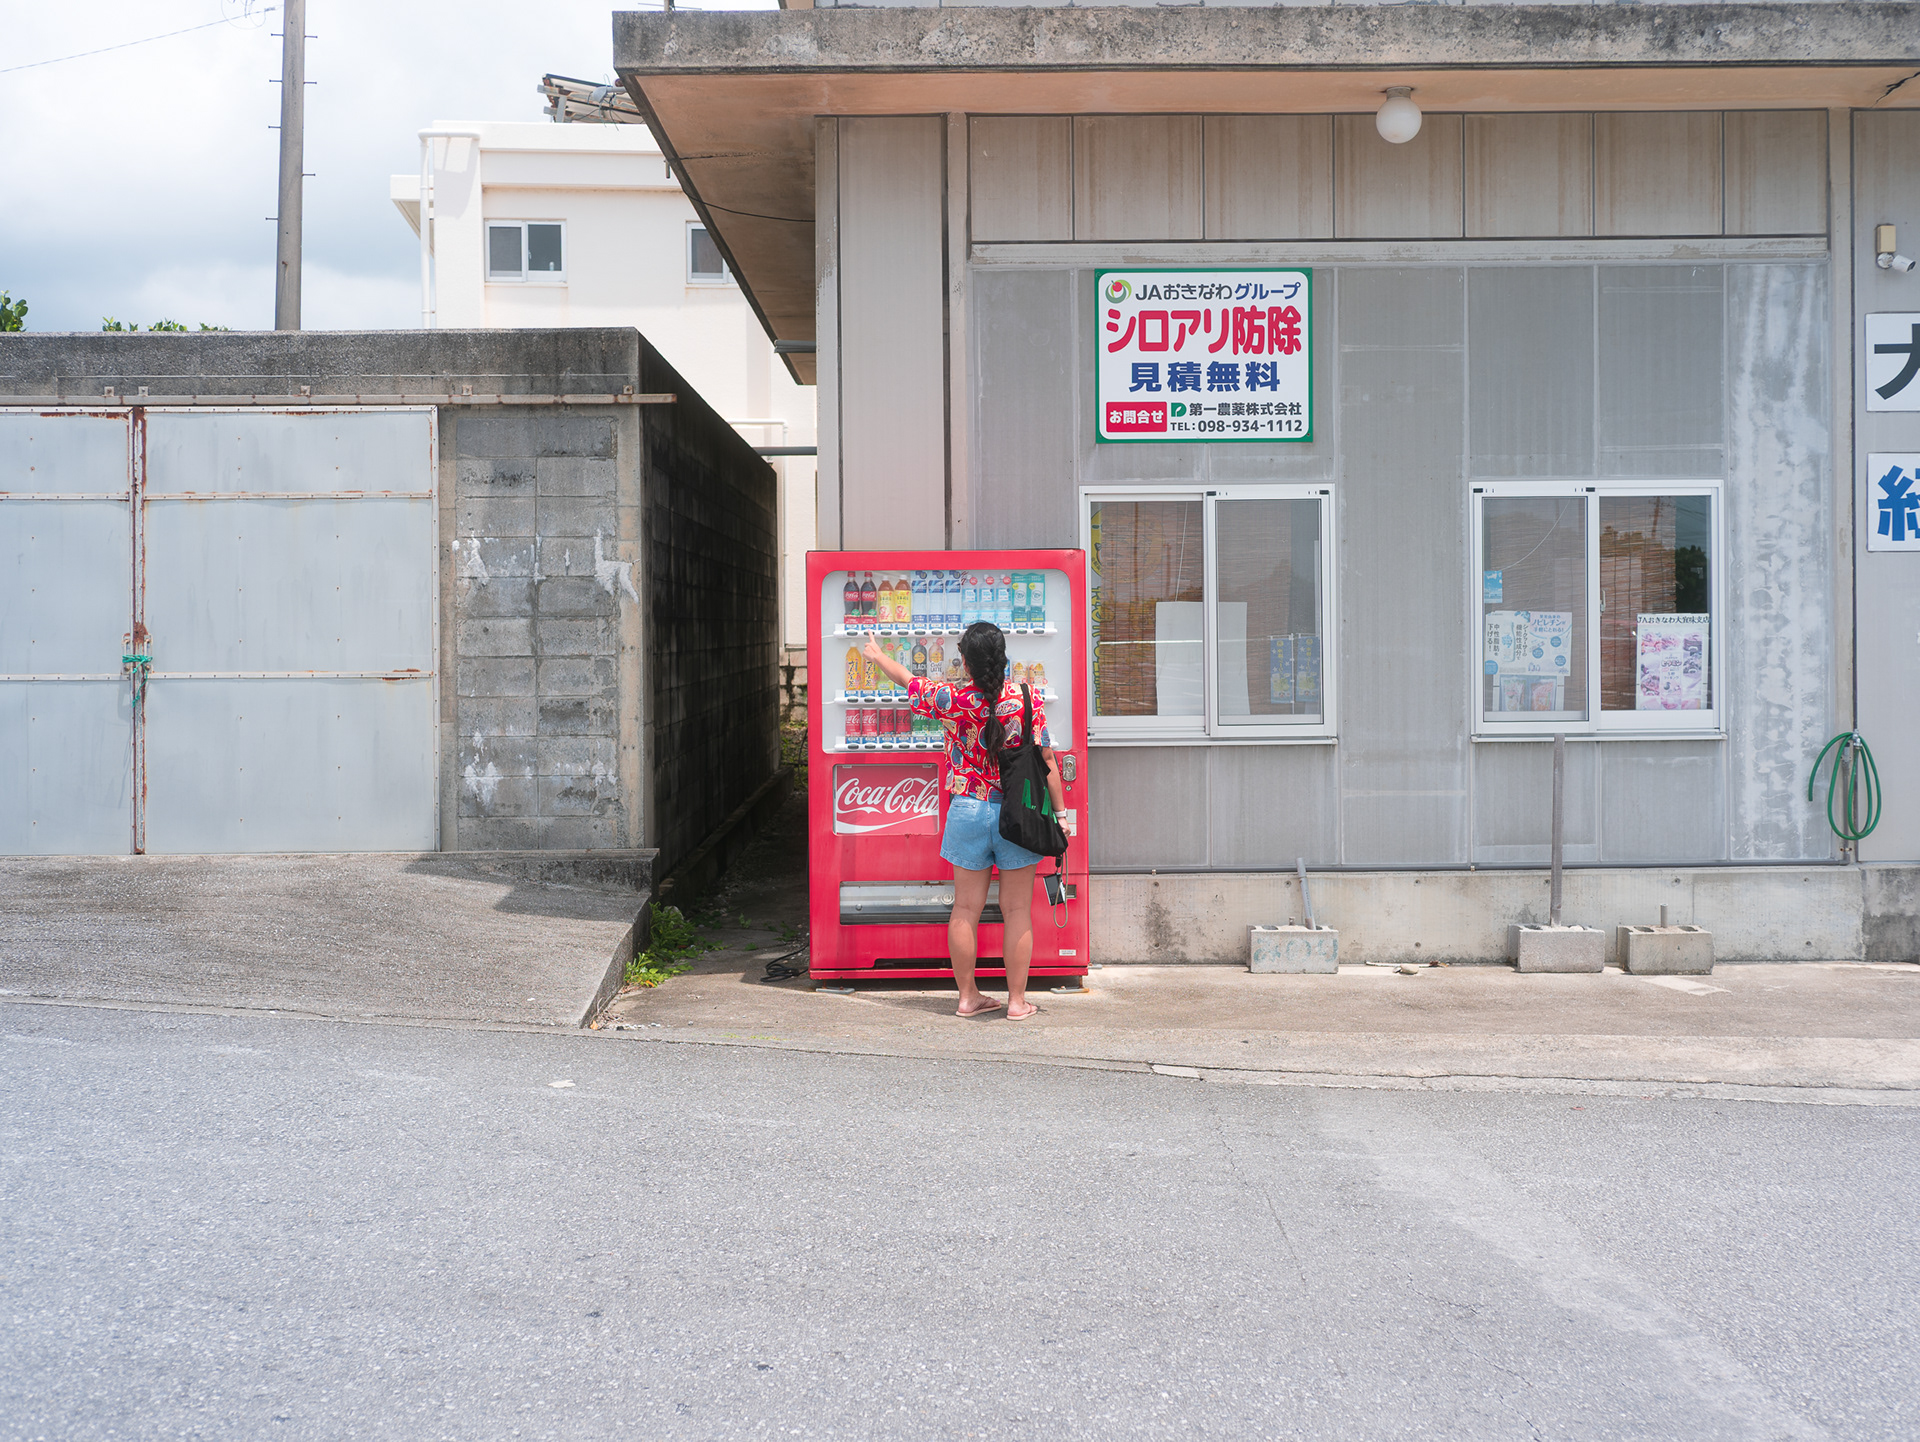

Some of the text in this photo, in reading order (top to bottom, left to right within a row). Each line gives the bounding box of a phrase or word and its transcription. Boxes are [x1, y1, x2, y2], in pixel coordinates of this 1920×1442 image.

[1135, 281, 1301, 301] JAおきなわグループ
[1106, 305, 1302, 356] シロアリ防除
[1128, 361, 1280, 393] 見積無料
[1109, 409, 1164, 425] お問合せ
[1189, 402, 1302, 416] 第一農薬株式会社
[836, 777, 940, 815] Coca-Cola
